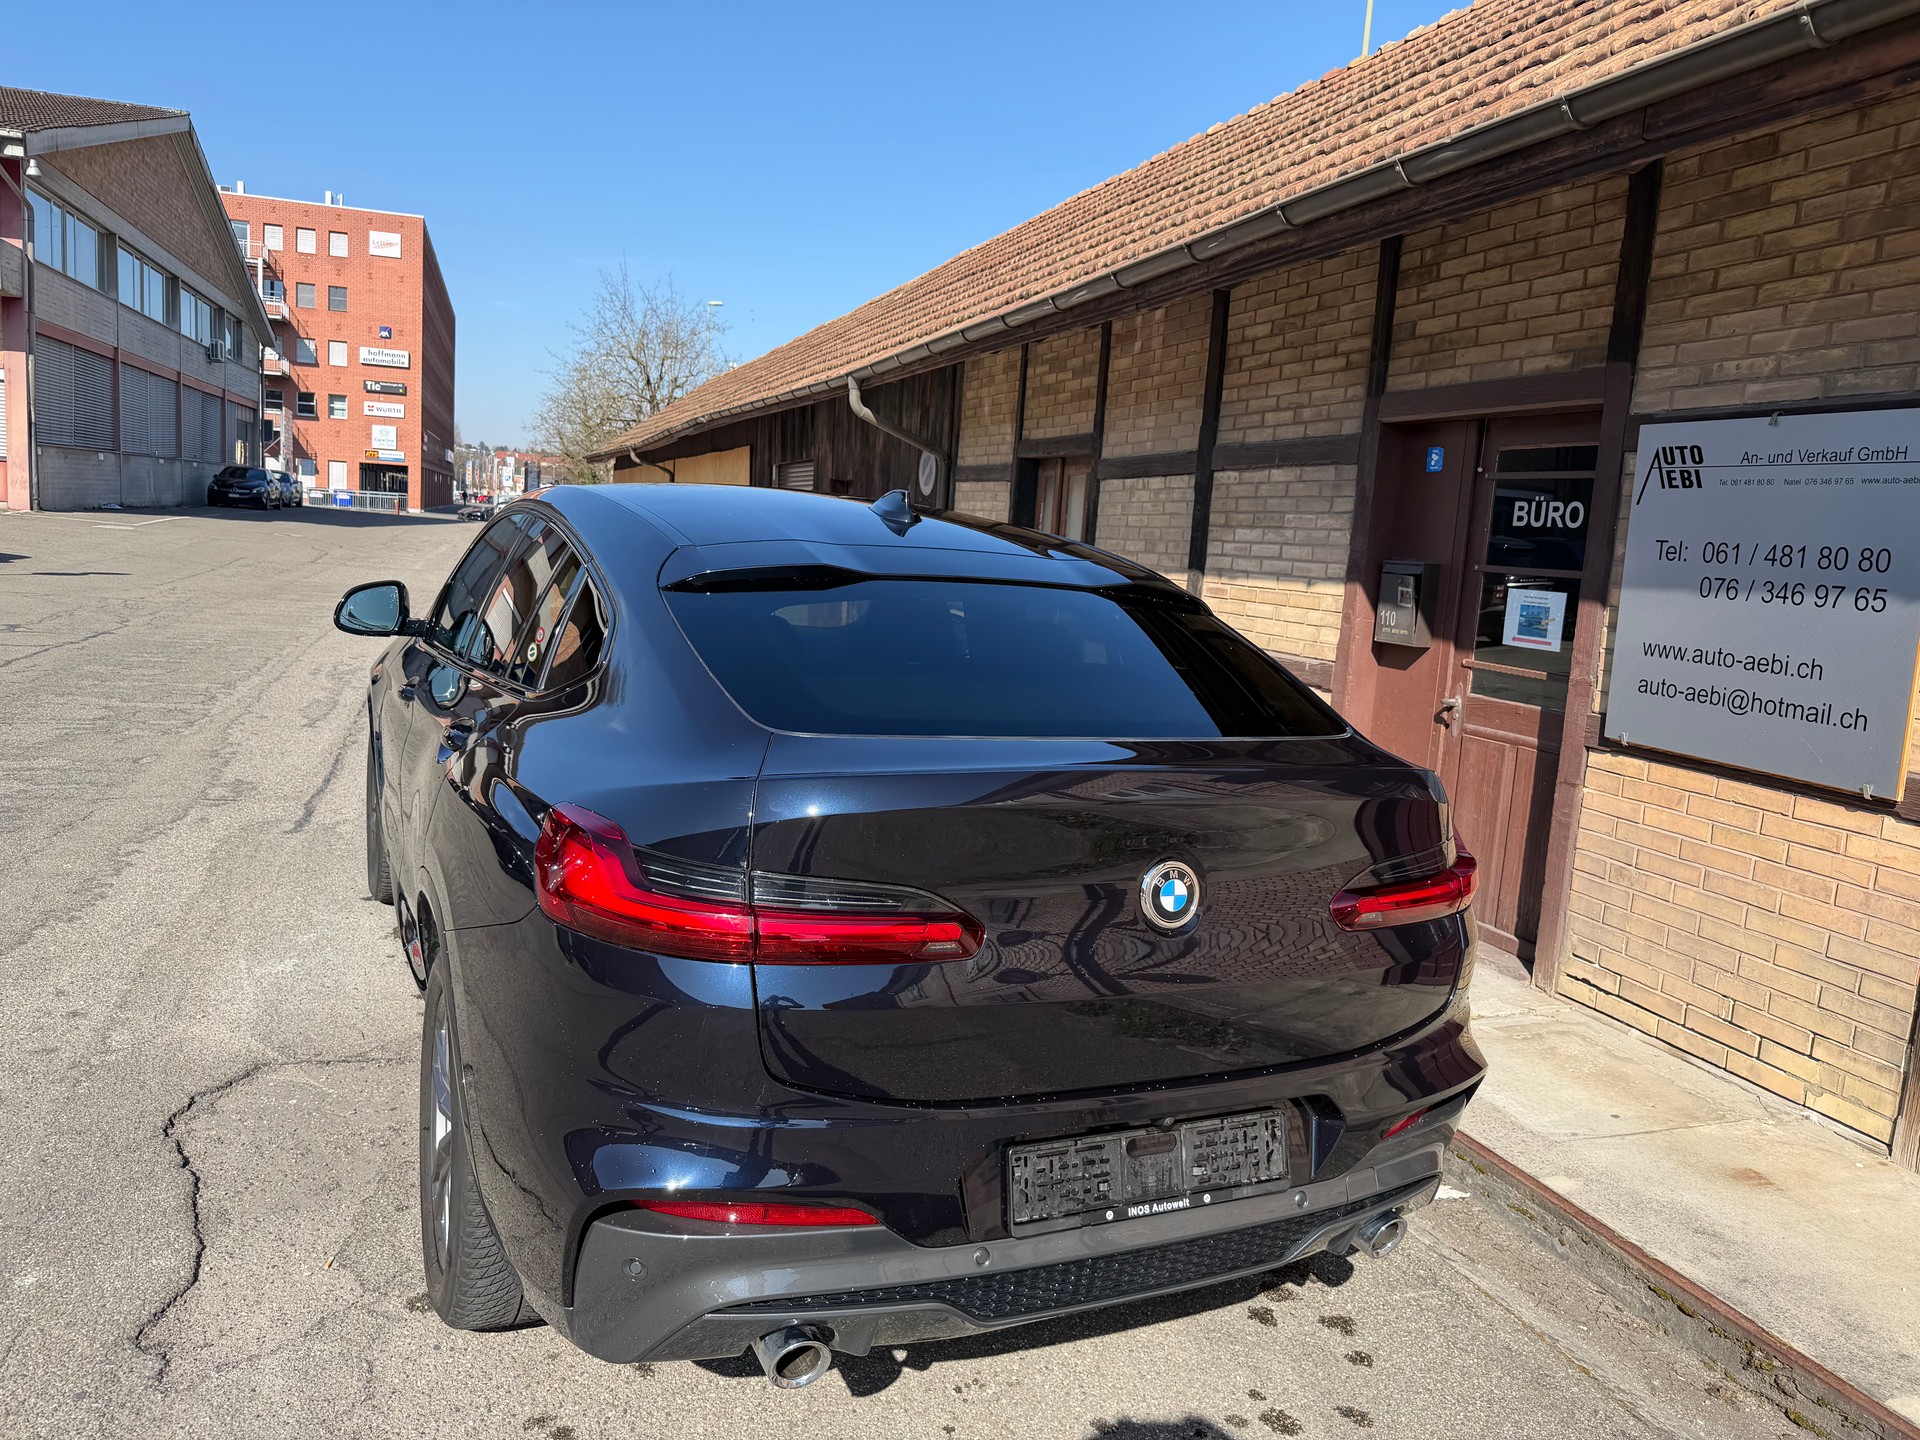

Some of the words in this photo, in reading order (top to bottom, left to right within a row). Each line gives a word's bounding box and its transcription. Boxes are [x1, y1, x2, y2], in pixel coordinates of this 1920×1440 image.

[362, 357, 406, 366] automobile
[367, 349, 406, 359] hoffmann
[1740, 451, 1764, 465] An-
[1767, 450, 1793, 464] und
[1798, 447, 1854, 463] Verkauf
[1857, 446, 1909, 462] GmbH
[1730, 478, 1742, 486] 061
[1743, 478, 1755, 486] 481
[1756, 478, 1765, 486] 80
[1766, 478, 1775, 486] 80
[1819, 477, 1833, 485] 346
[1834, 477, 1844, 485] 97
[1844, 477, 1855, 485] 65
[1512, 496, 1585, 529] BÜRO
[1655, 539, 1689, 562] Tel:
[1702, 541, 1741, 565] 061
[1748, 543, 1759, 566] /
[1763, 544, 1807, 569] 481
[1817, 545, 1849, 571] 80
[1857, 547, 1892, 573] 80
[1699, 576, 1740, 601] 076
[1745, 579, 1755, 602] /
[1761, 580, 1806, 606] 346
[1813, 584, 1847, 609] 97
[1854, 587, 1888, 613] 65
[1380, 610, 1396, 626] 110
[1642, 641, 1824, 681] www.auto-aebi.ch
[1638, 678, 1868, 732] auto-aebi@hotmail.ch
[1128, 1204, 1150, 1217] INOS
[1152, 1198, 1190, 1213] Autowelt
